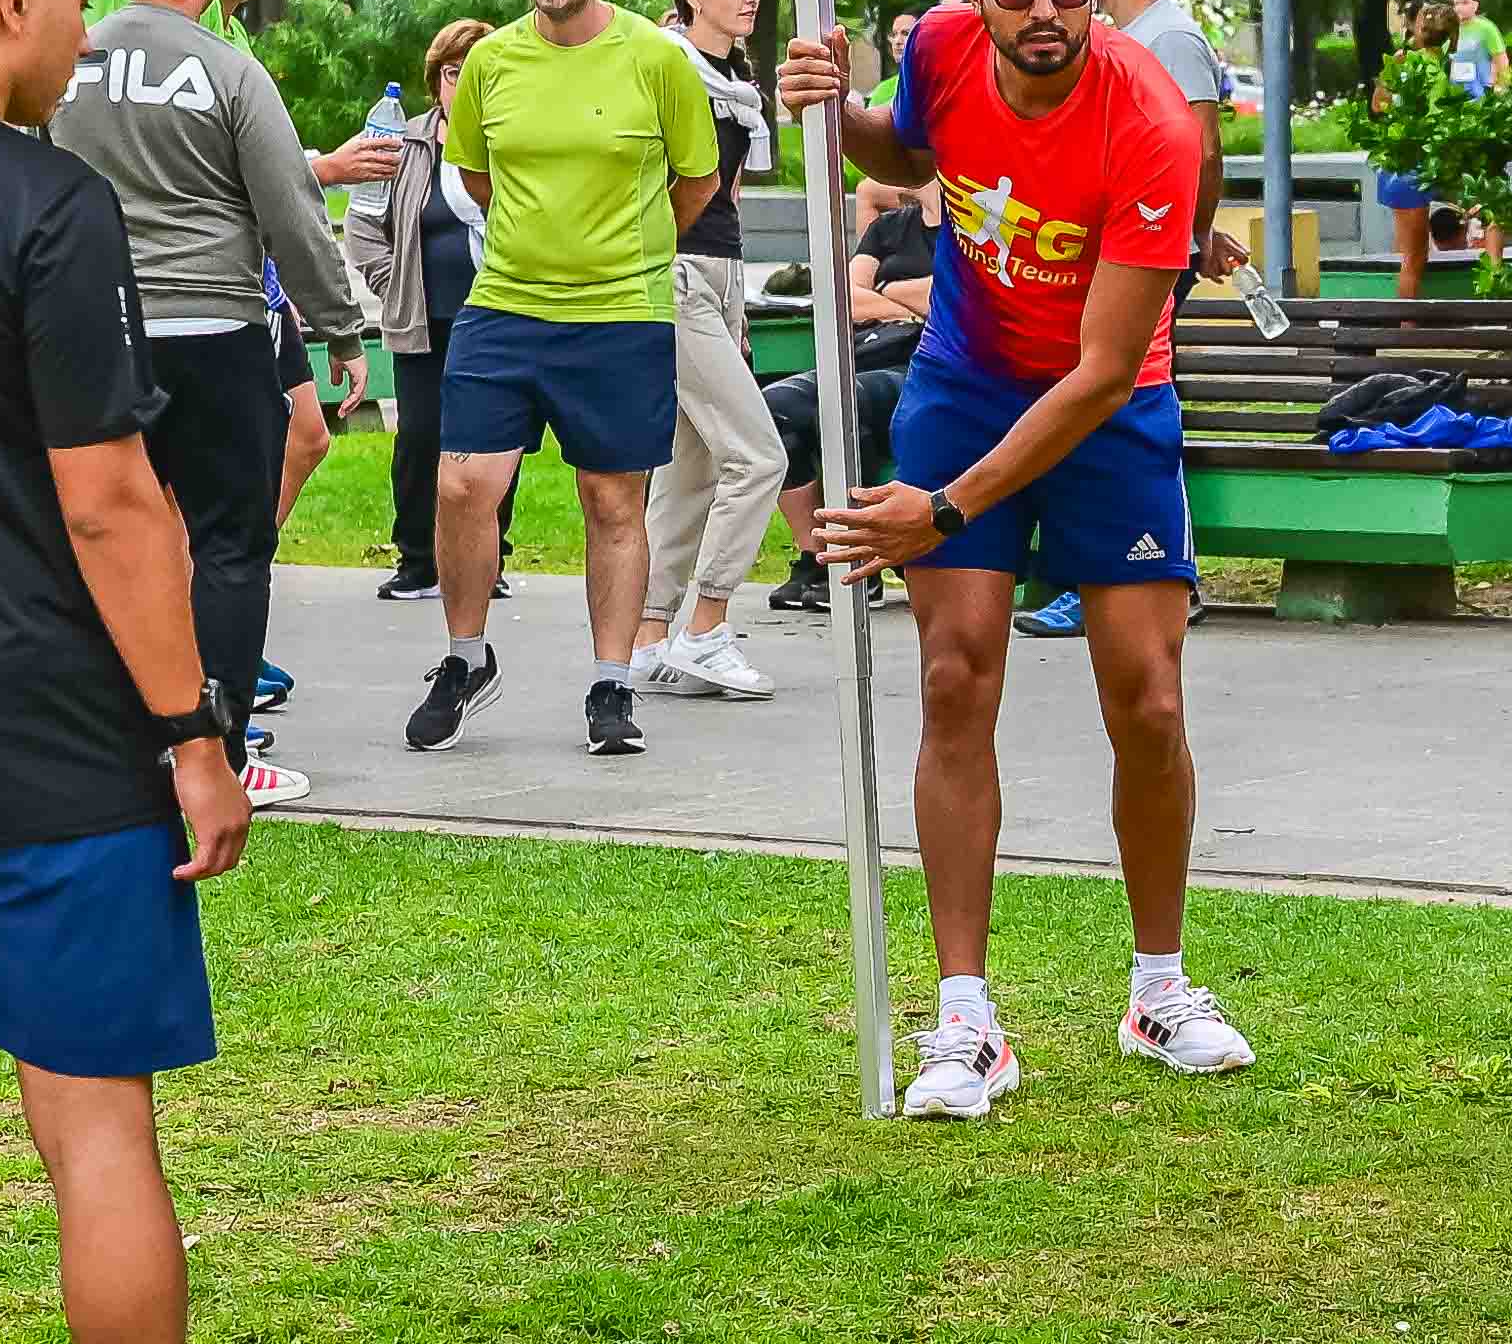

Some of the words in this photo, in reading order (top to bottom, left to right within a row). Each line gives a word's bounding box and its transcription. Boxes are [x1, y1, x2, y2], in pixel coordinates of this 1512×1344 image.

[63, 47, 216, 112] FILA
[1010, 256, 1077, 286] Team
[1127, 549, 1165, 561] adidas
